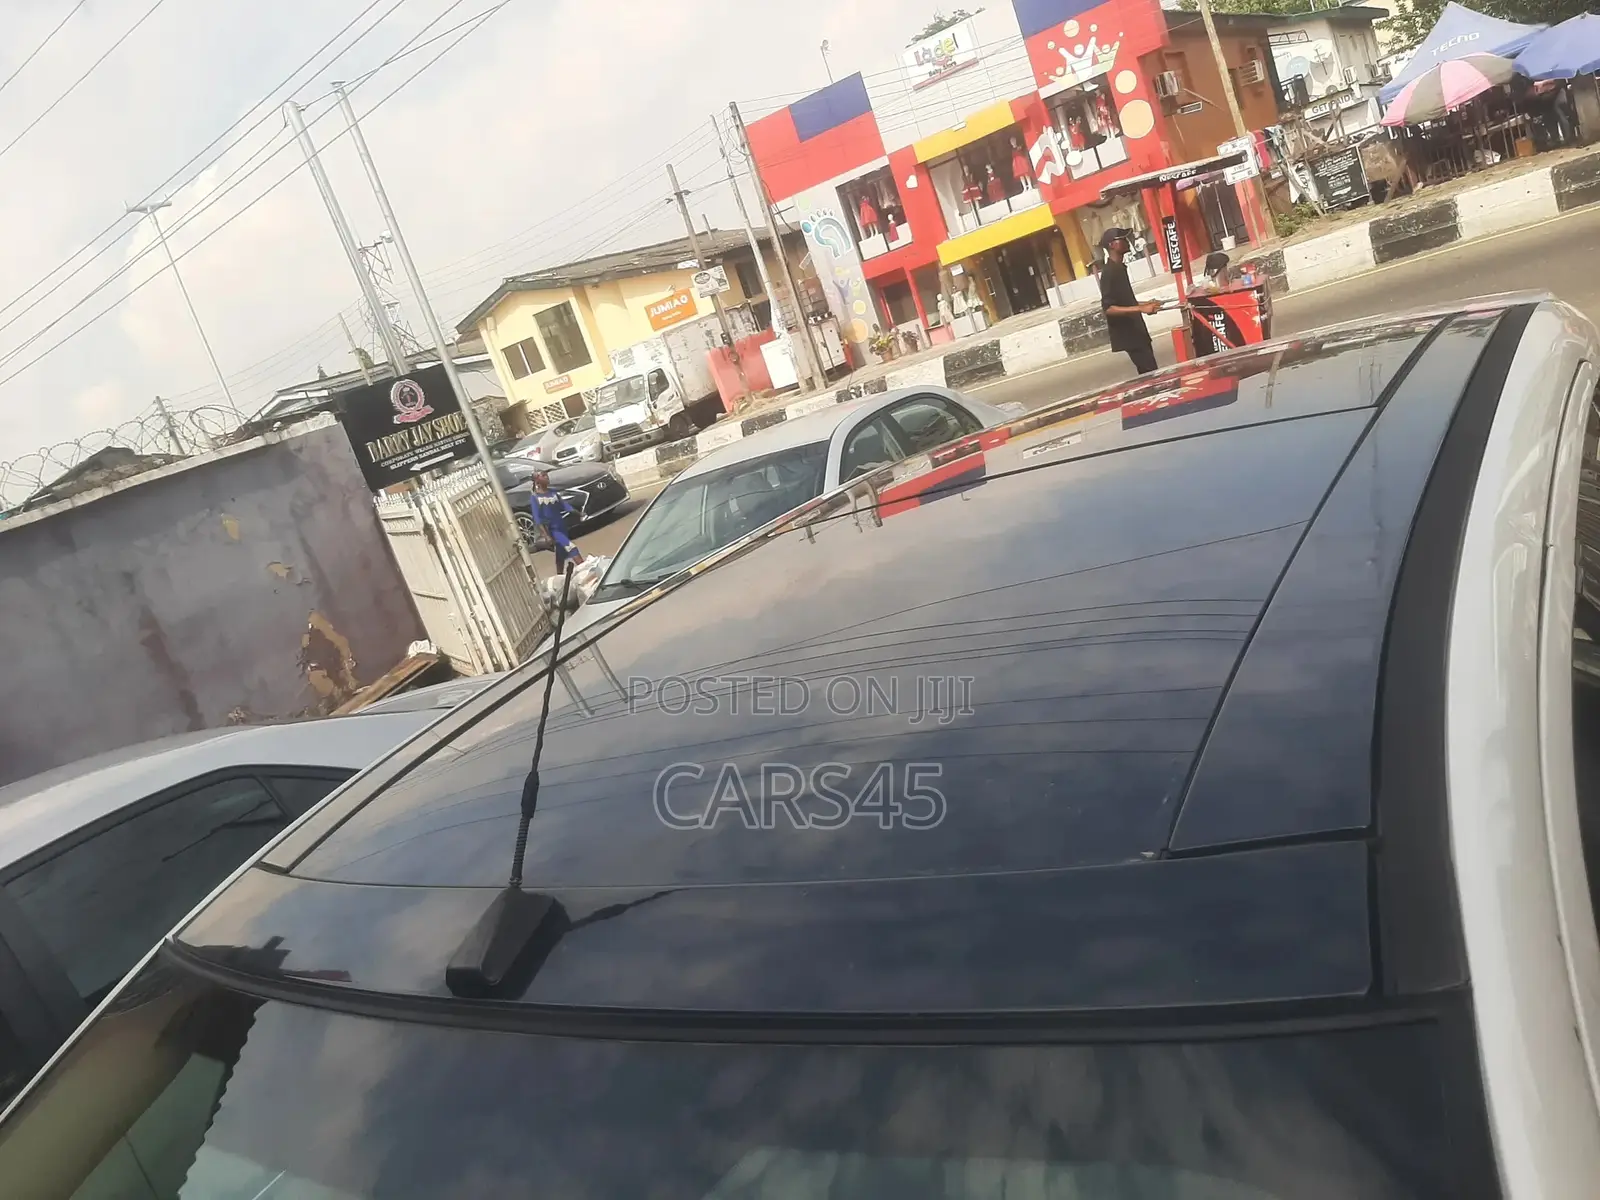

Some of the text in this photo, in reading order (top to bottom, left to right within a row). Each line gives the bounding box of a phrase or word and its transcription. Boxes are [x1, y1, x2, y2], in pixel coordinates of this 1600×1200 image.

[1431, 32, 1480, 56] TECNO
[1311, 102, 1329, 115] GET
[411, 421, 433, 446] JAY
